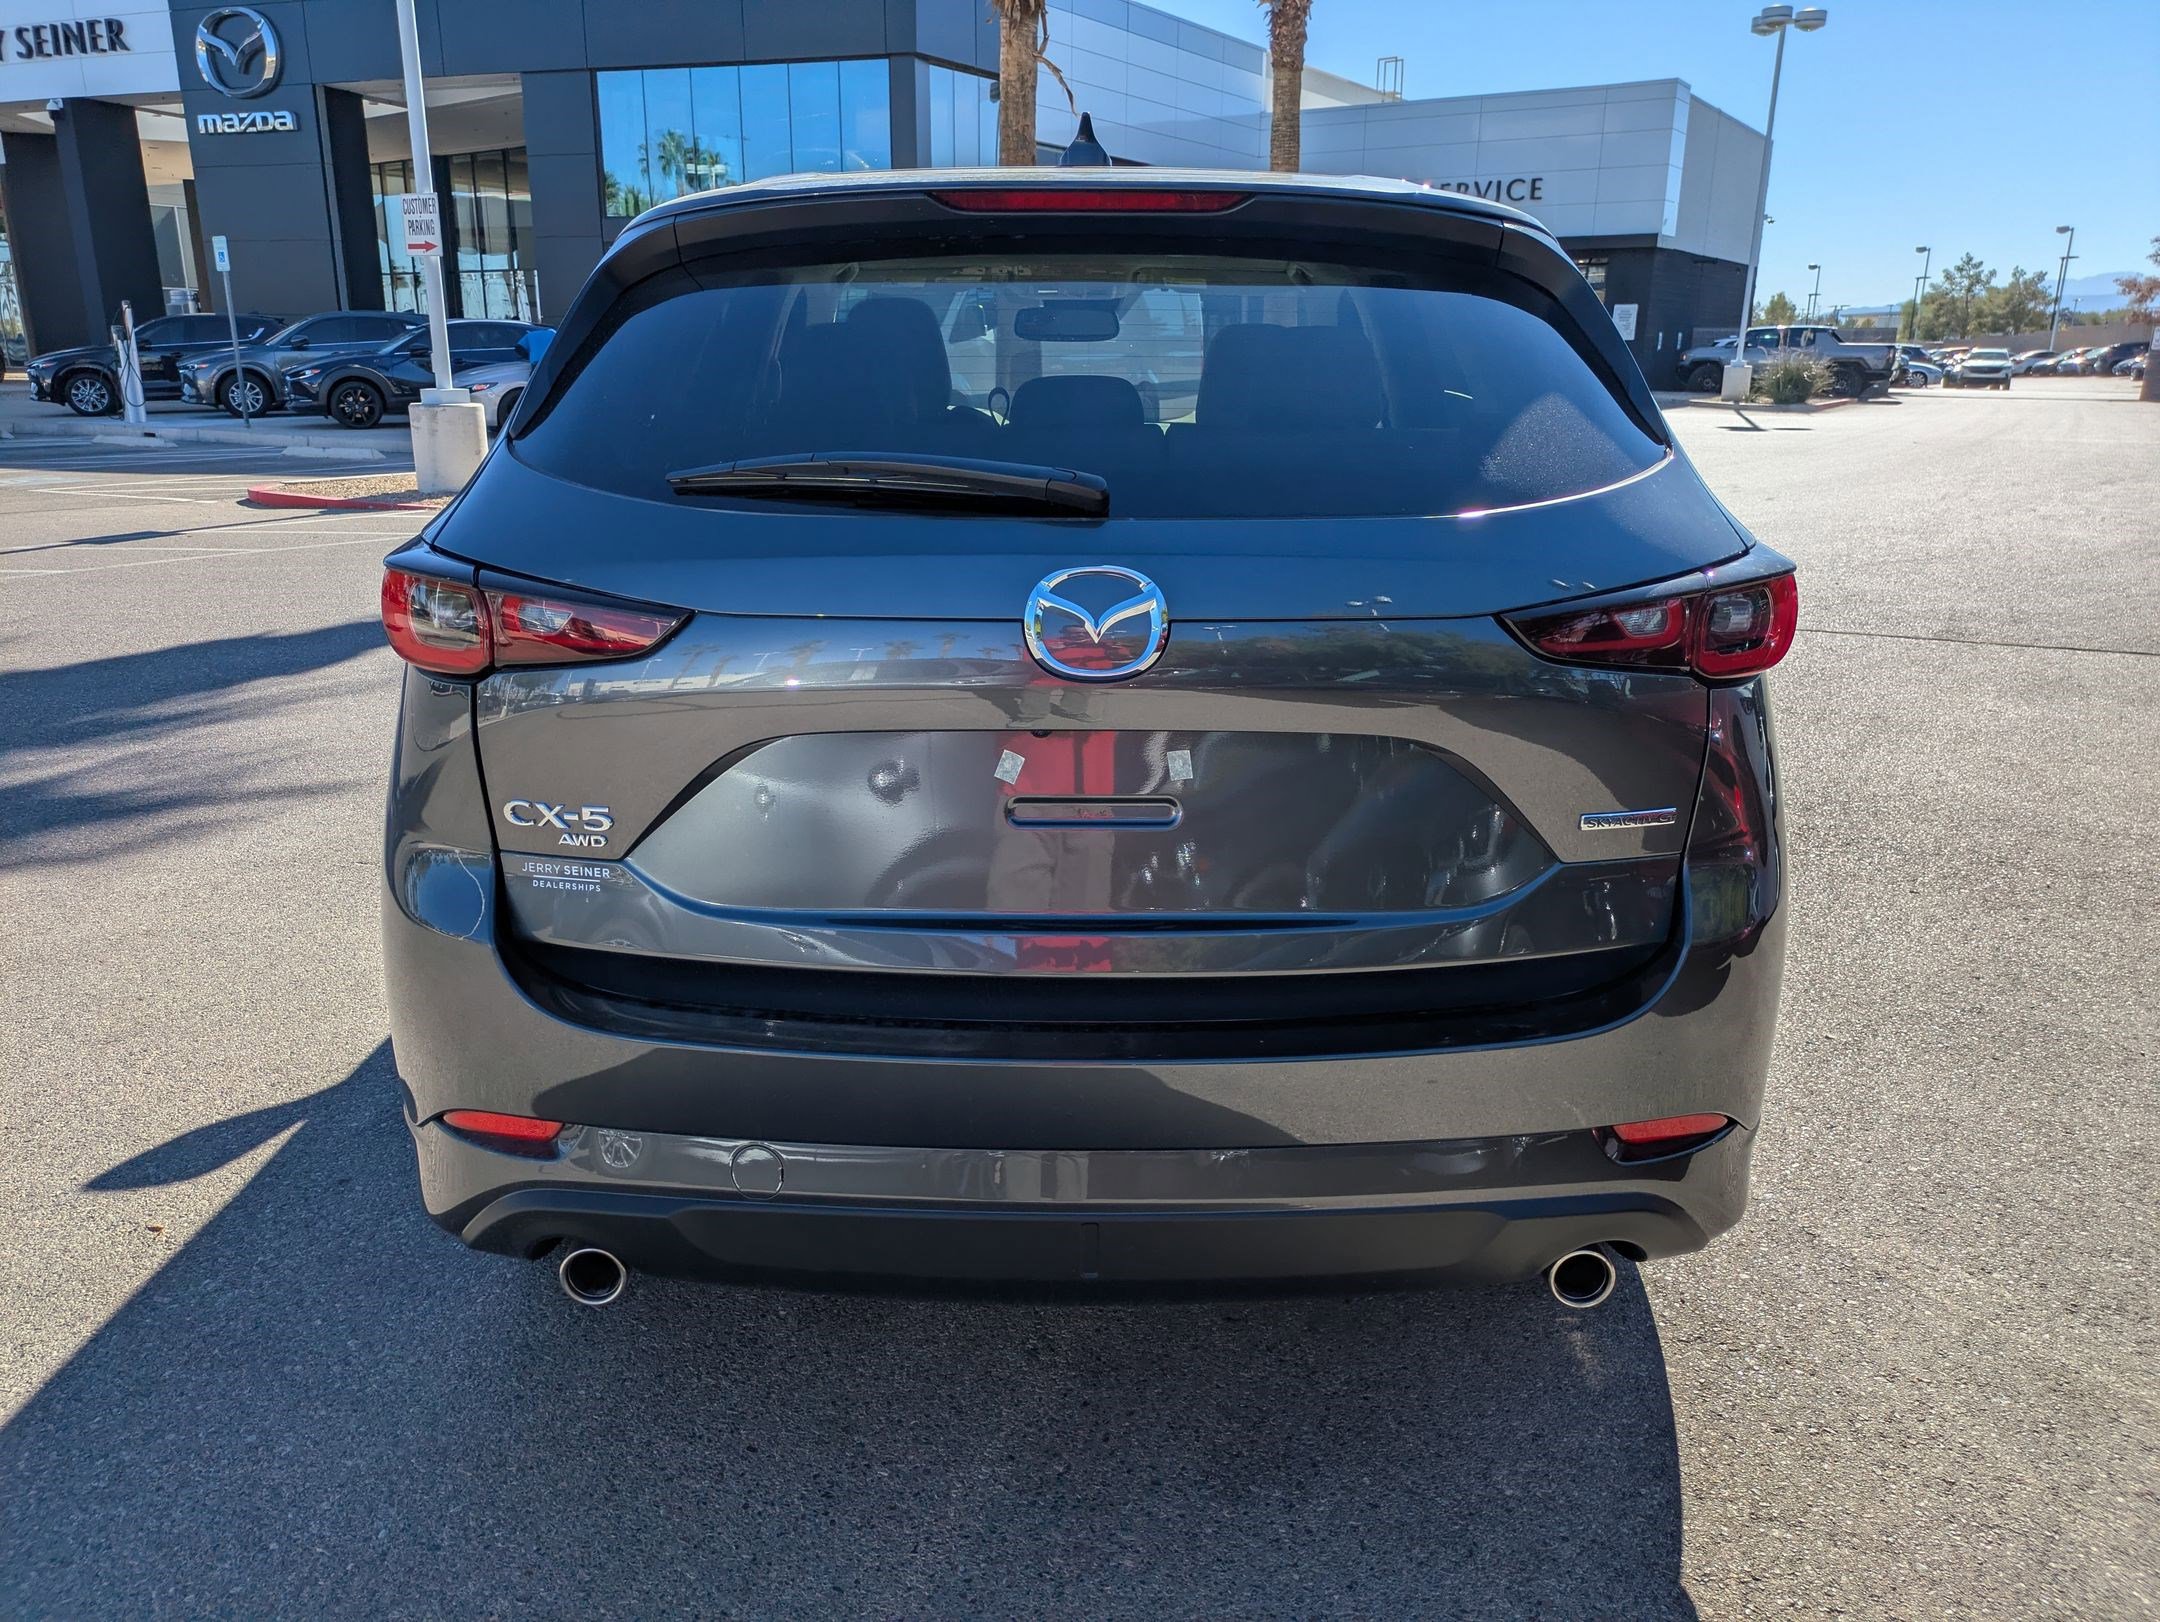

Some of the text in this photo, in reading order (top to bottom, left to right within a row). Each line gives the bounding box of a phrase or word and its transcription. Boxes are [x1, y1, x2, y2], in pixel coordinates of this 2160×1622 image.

[15, 18, 131, 59] SEINER
[1439, 177, 1544, 203] RVICE
[402, 197, 438, 215] CUSTOMER
[407, 219, 436, 236] PARKING
[503, 799, 615, 832] CX-5
[558, 832, 608, 848] AWD
[522, 862, 611, 878] JERRY SEINER
[532, 880, 601, 892] DEALERSHIPS
